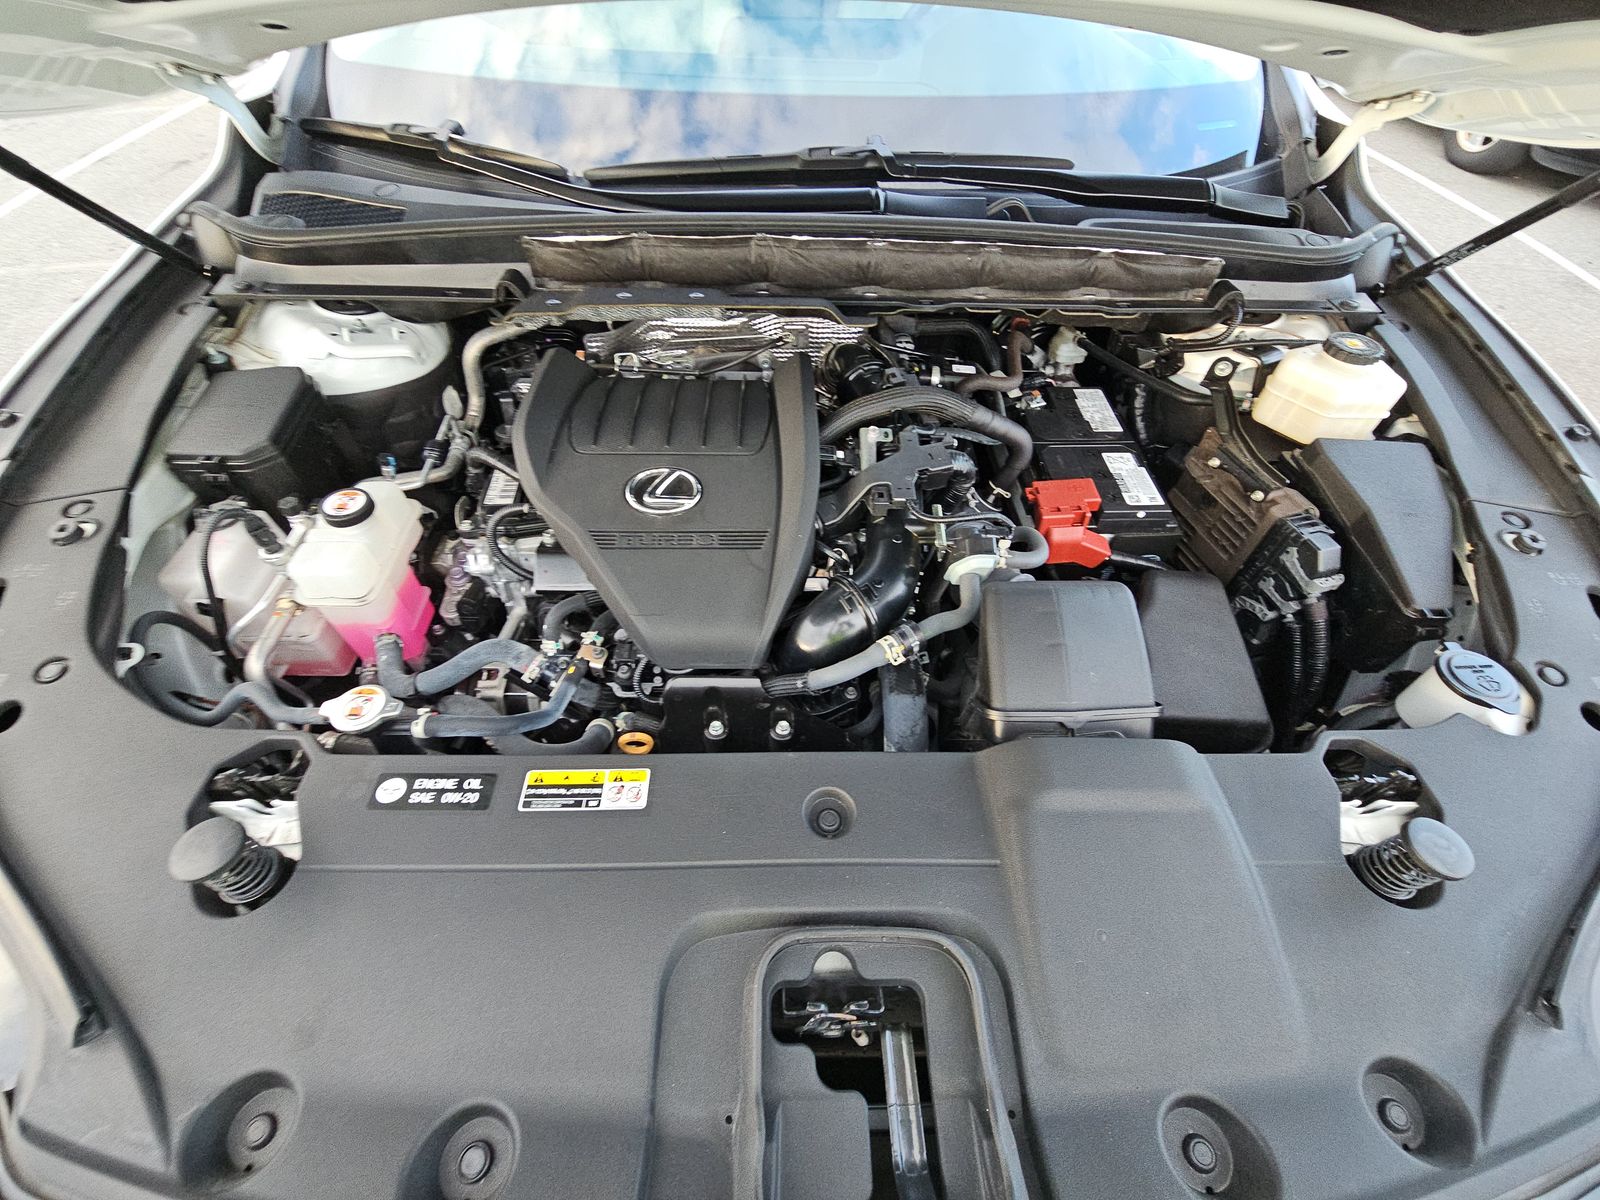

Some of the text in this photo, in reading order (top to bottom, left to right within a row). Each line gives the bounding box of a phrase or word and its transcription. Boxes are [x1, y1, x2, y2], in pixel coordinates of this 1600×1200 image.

[618, 533, 716, 545] TURBO
[413, 778, 484, 790] ENGINE OIL
[408, 792, 480, 804] SAE 0W-20
